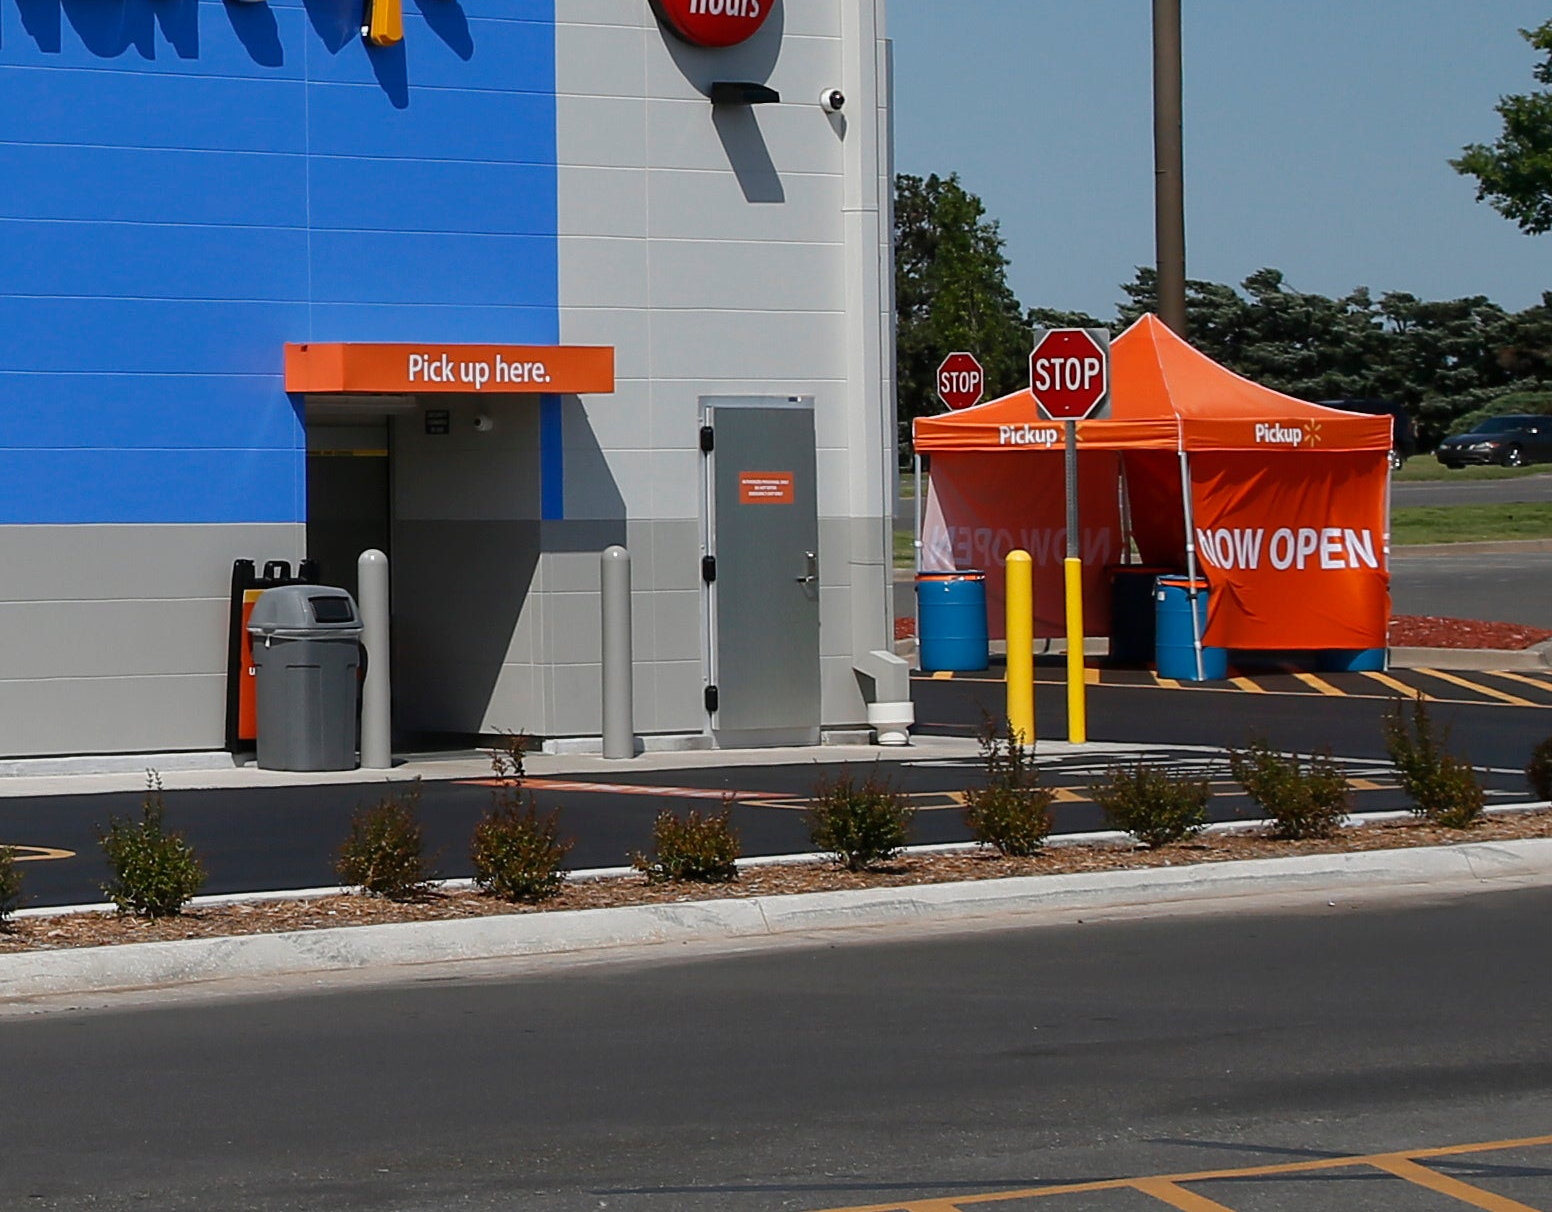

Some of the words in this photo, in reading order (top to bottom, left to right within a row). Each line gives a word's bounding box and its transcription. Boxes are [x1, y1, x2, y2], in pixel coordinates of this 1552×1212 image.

[408, 353, 456, 382] Pick
[460, 362, 490, 390] up
[495, 354, 551, 383] here.
[941, 371, 980, 393] STOP
[1035, 356, 1100, 391] STOP
[998, 424, 1058, 448] Pickup
[1255, 423, 1303, 447] Pickup
[1196, 527, 1264, 569] NOW
[1269, 527, 1378, 569] OPEN
